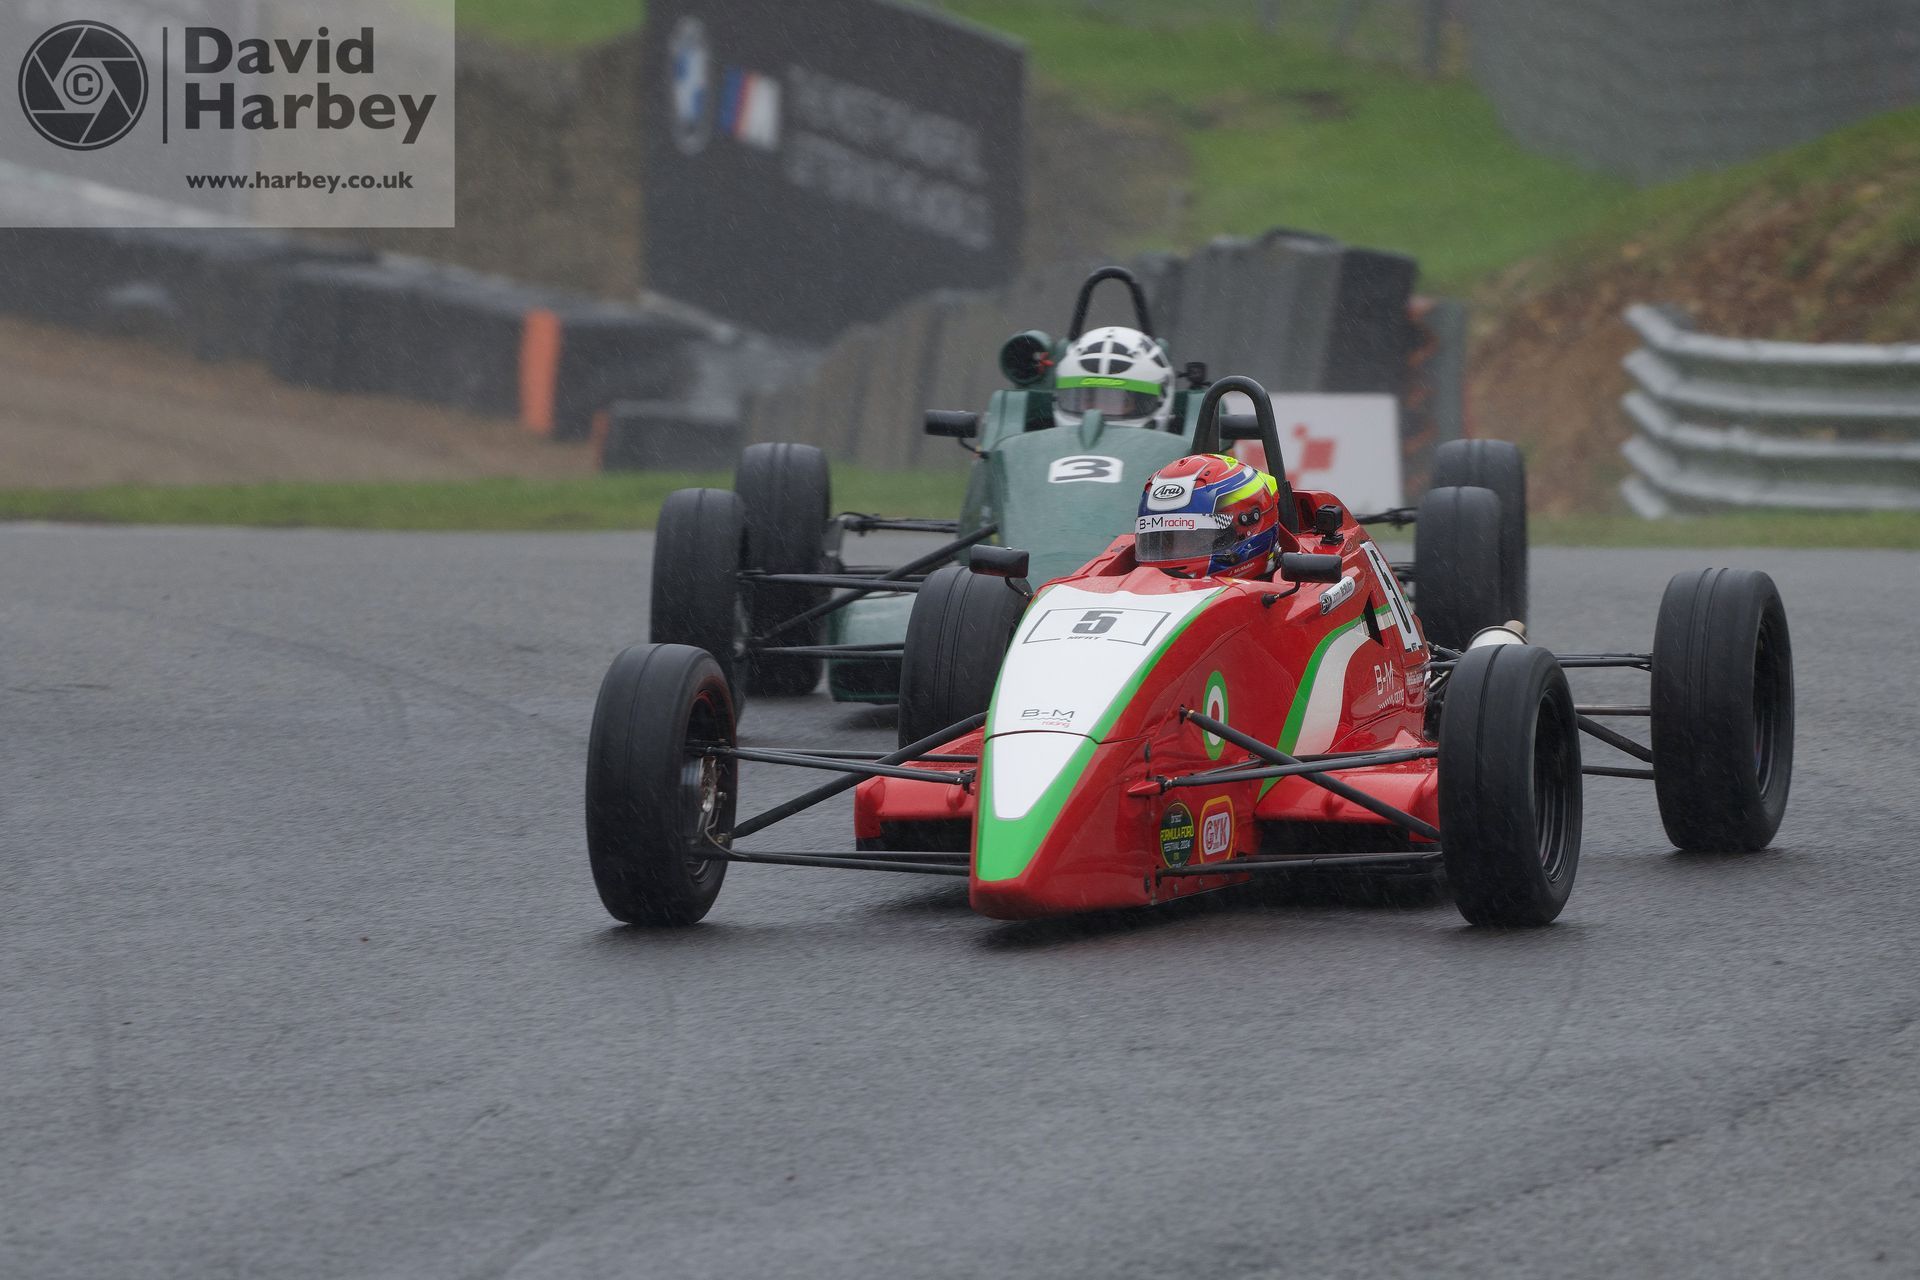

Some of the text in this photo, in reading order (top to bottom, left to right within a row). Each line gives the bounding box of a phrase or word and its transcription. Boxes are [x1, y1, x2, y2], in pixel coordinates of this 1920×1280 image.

[1053, 458, 1111, 481] 3
[1155, 486, 1181, 497] Arai
[1139, 517, 1195, 530] B-M racing
[1071, 610, 1124, 634] 5
[1021, 708, 1075, 718] B-M
